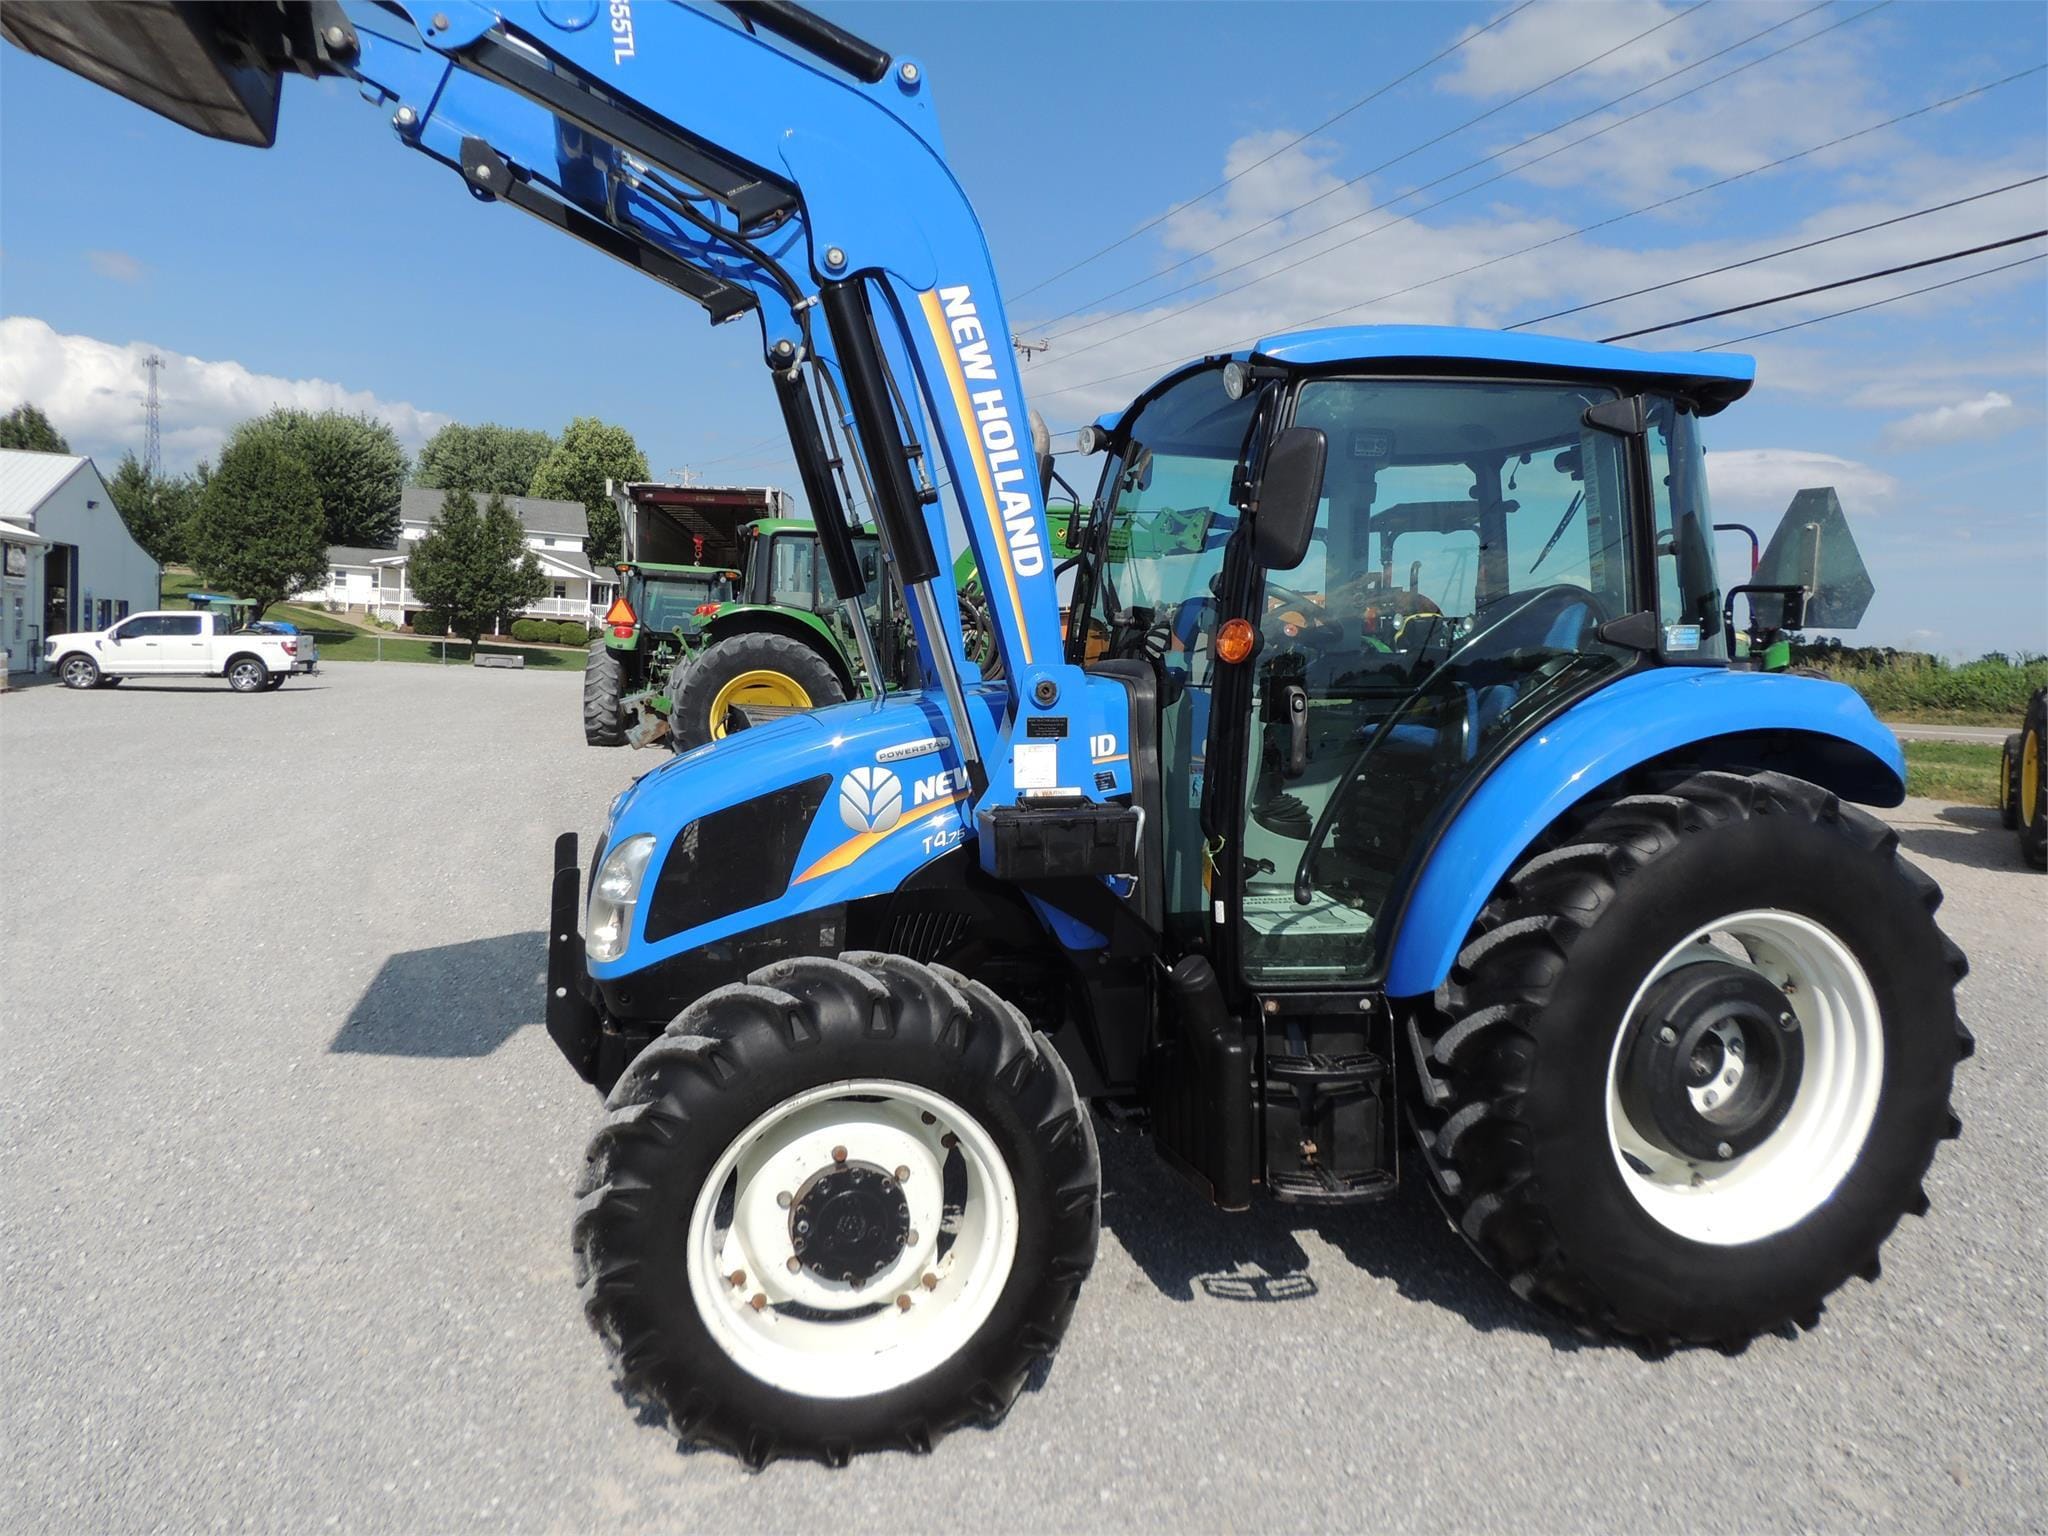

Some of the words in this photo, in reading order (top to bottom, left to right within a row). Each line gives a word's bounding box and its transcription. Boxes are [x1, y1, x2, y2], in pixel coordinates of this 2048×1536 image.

[608, 0, 635, 65] 55TL
[939, 285, 997, 380] NEW
[972, 389, 1045, 577] HOLLAND
[922, 827, 966, 855] T4.75
